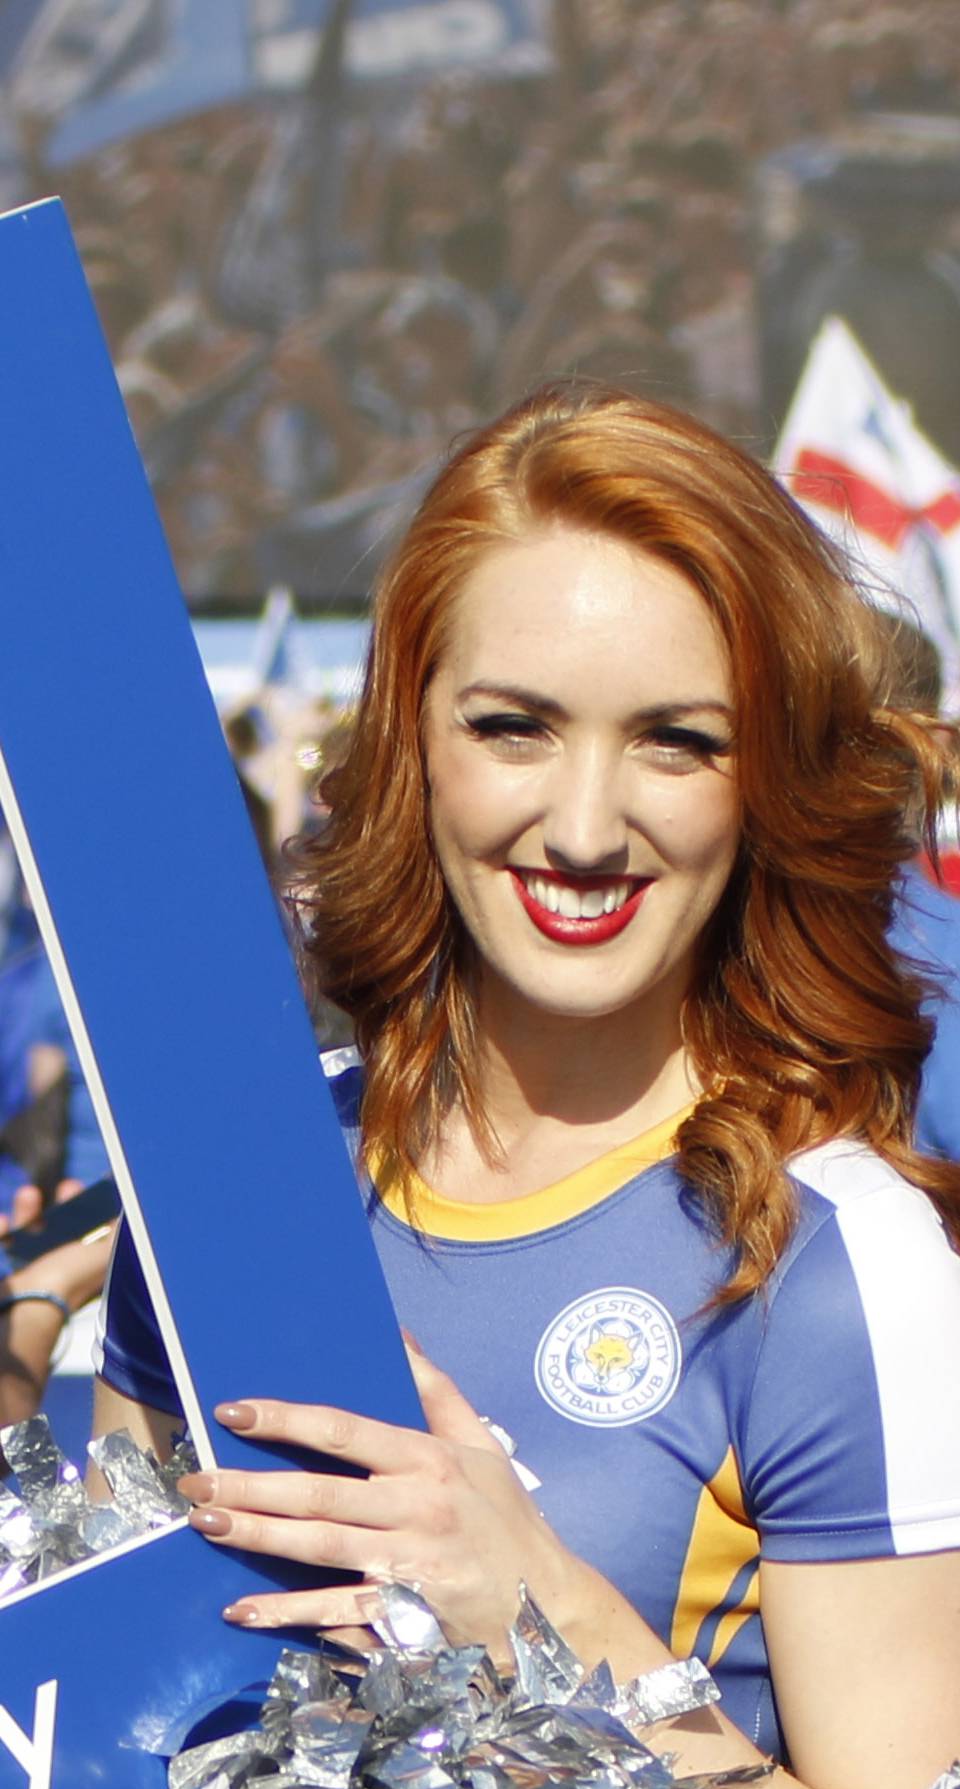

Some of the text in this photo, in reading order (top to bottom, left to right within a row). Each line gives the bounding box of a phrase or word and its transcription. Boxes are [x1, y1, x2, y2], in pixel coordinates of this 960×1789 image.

[557, 1299, 669, 1367] LEICESTER CITY
[547, 1354, 664, 1414] FOOTBALL CLUB
